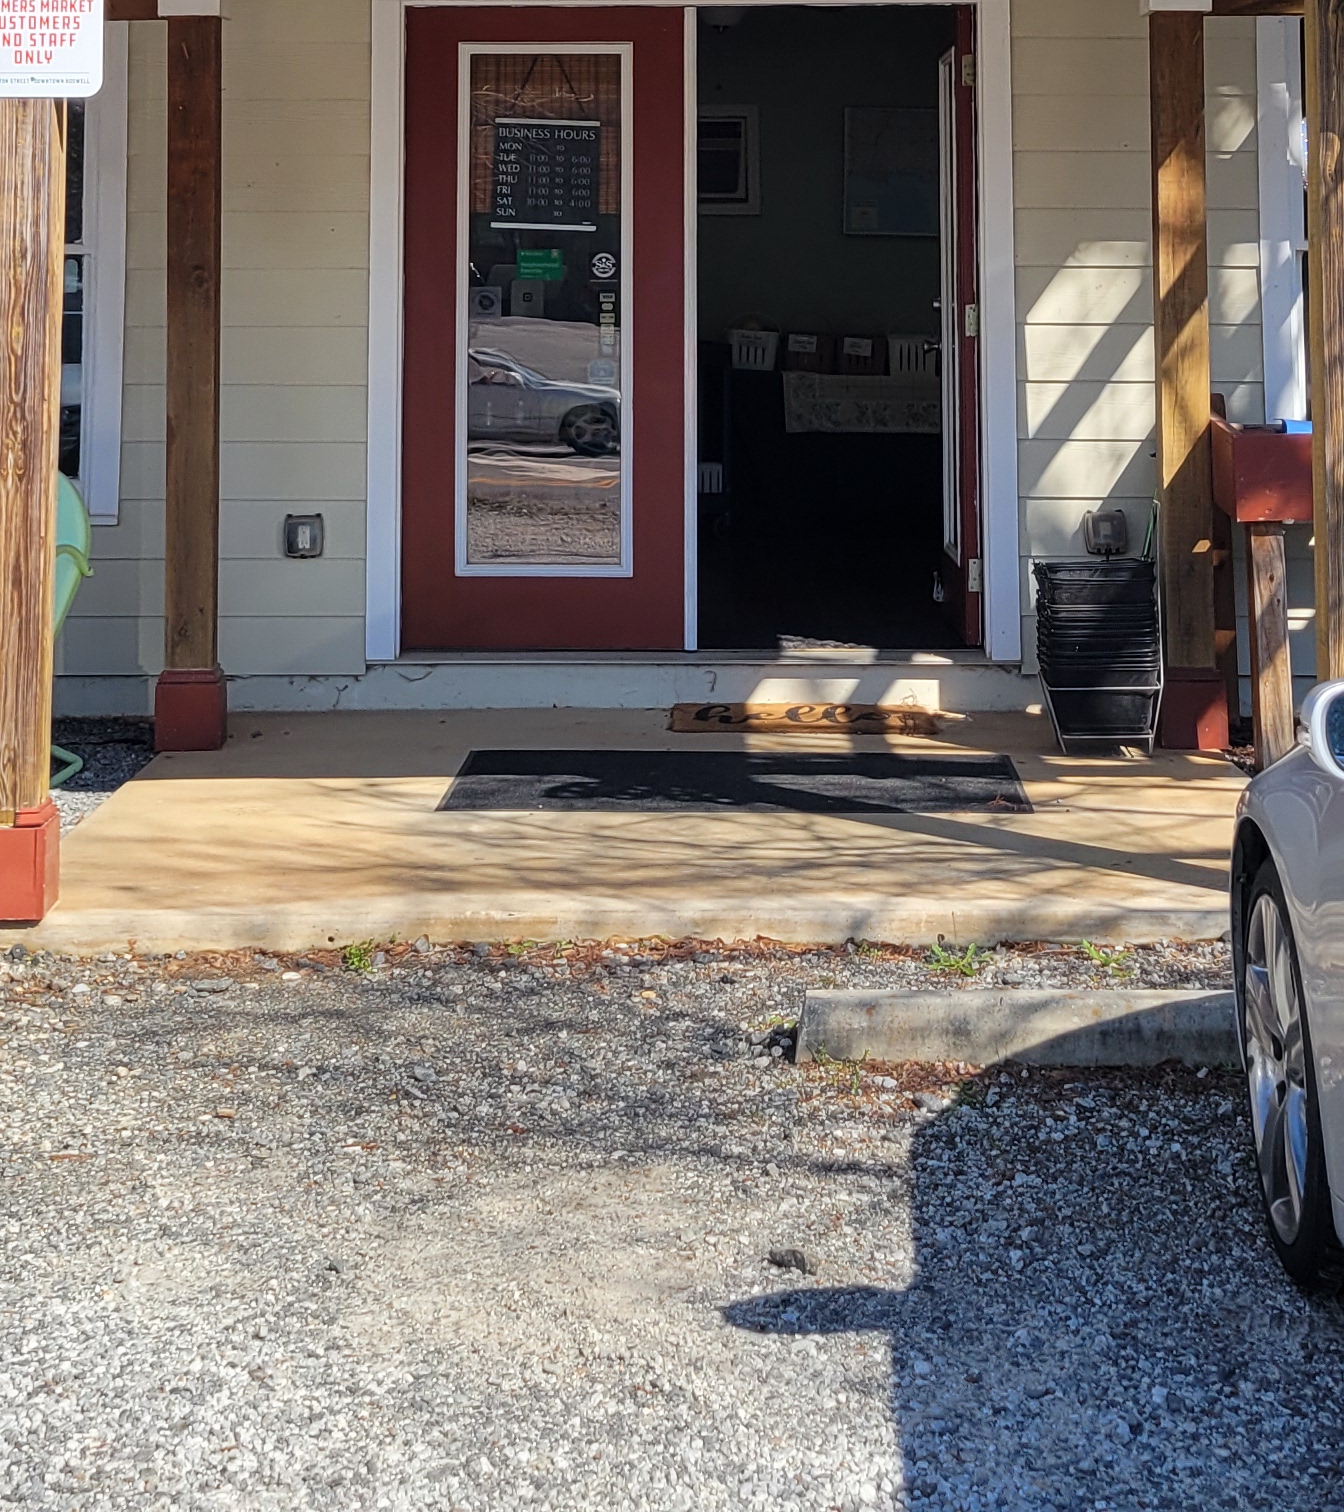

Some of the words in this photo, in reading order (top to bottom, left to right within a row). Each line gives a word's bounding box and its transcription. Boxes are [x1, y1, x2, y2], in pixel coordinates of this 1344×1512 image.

[40, 0, 94, 13] MARKET
[30, 33, 77, 47] STAFF
[14, 50, 53, 64] ONLY
[498, 127, 551, 139] BUSINESS
[555, 129, 596, 140] HOURS
[499, 142, 522, 150] MON
[499, 153, 517, 161] TUE
[498, 164, 520, 173] WED
[498, 175, 517, 183] THU
[497, 186, 511, 194] FRI
[497, 197, 512, 205] SAT
[496, 208, 515, 216] SUN
[693, 705, 892, 724] hello
